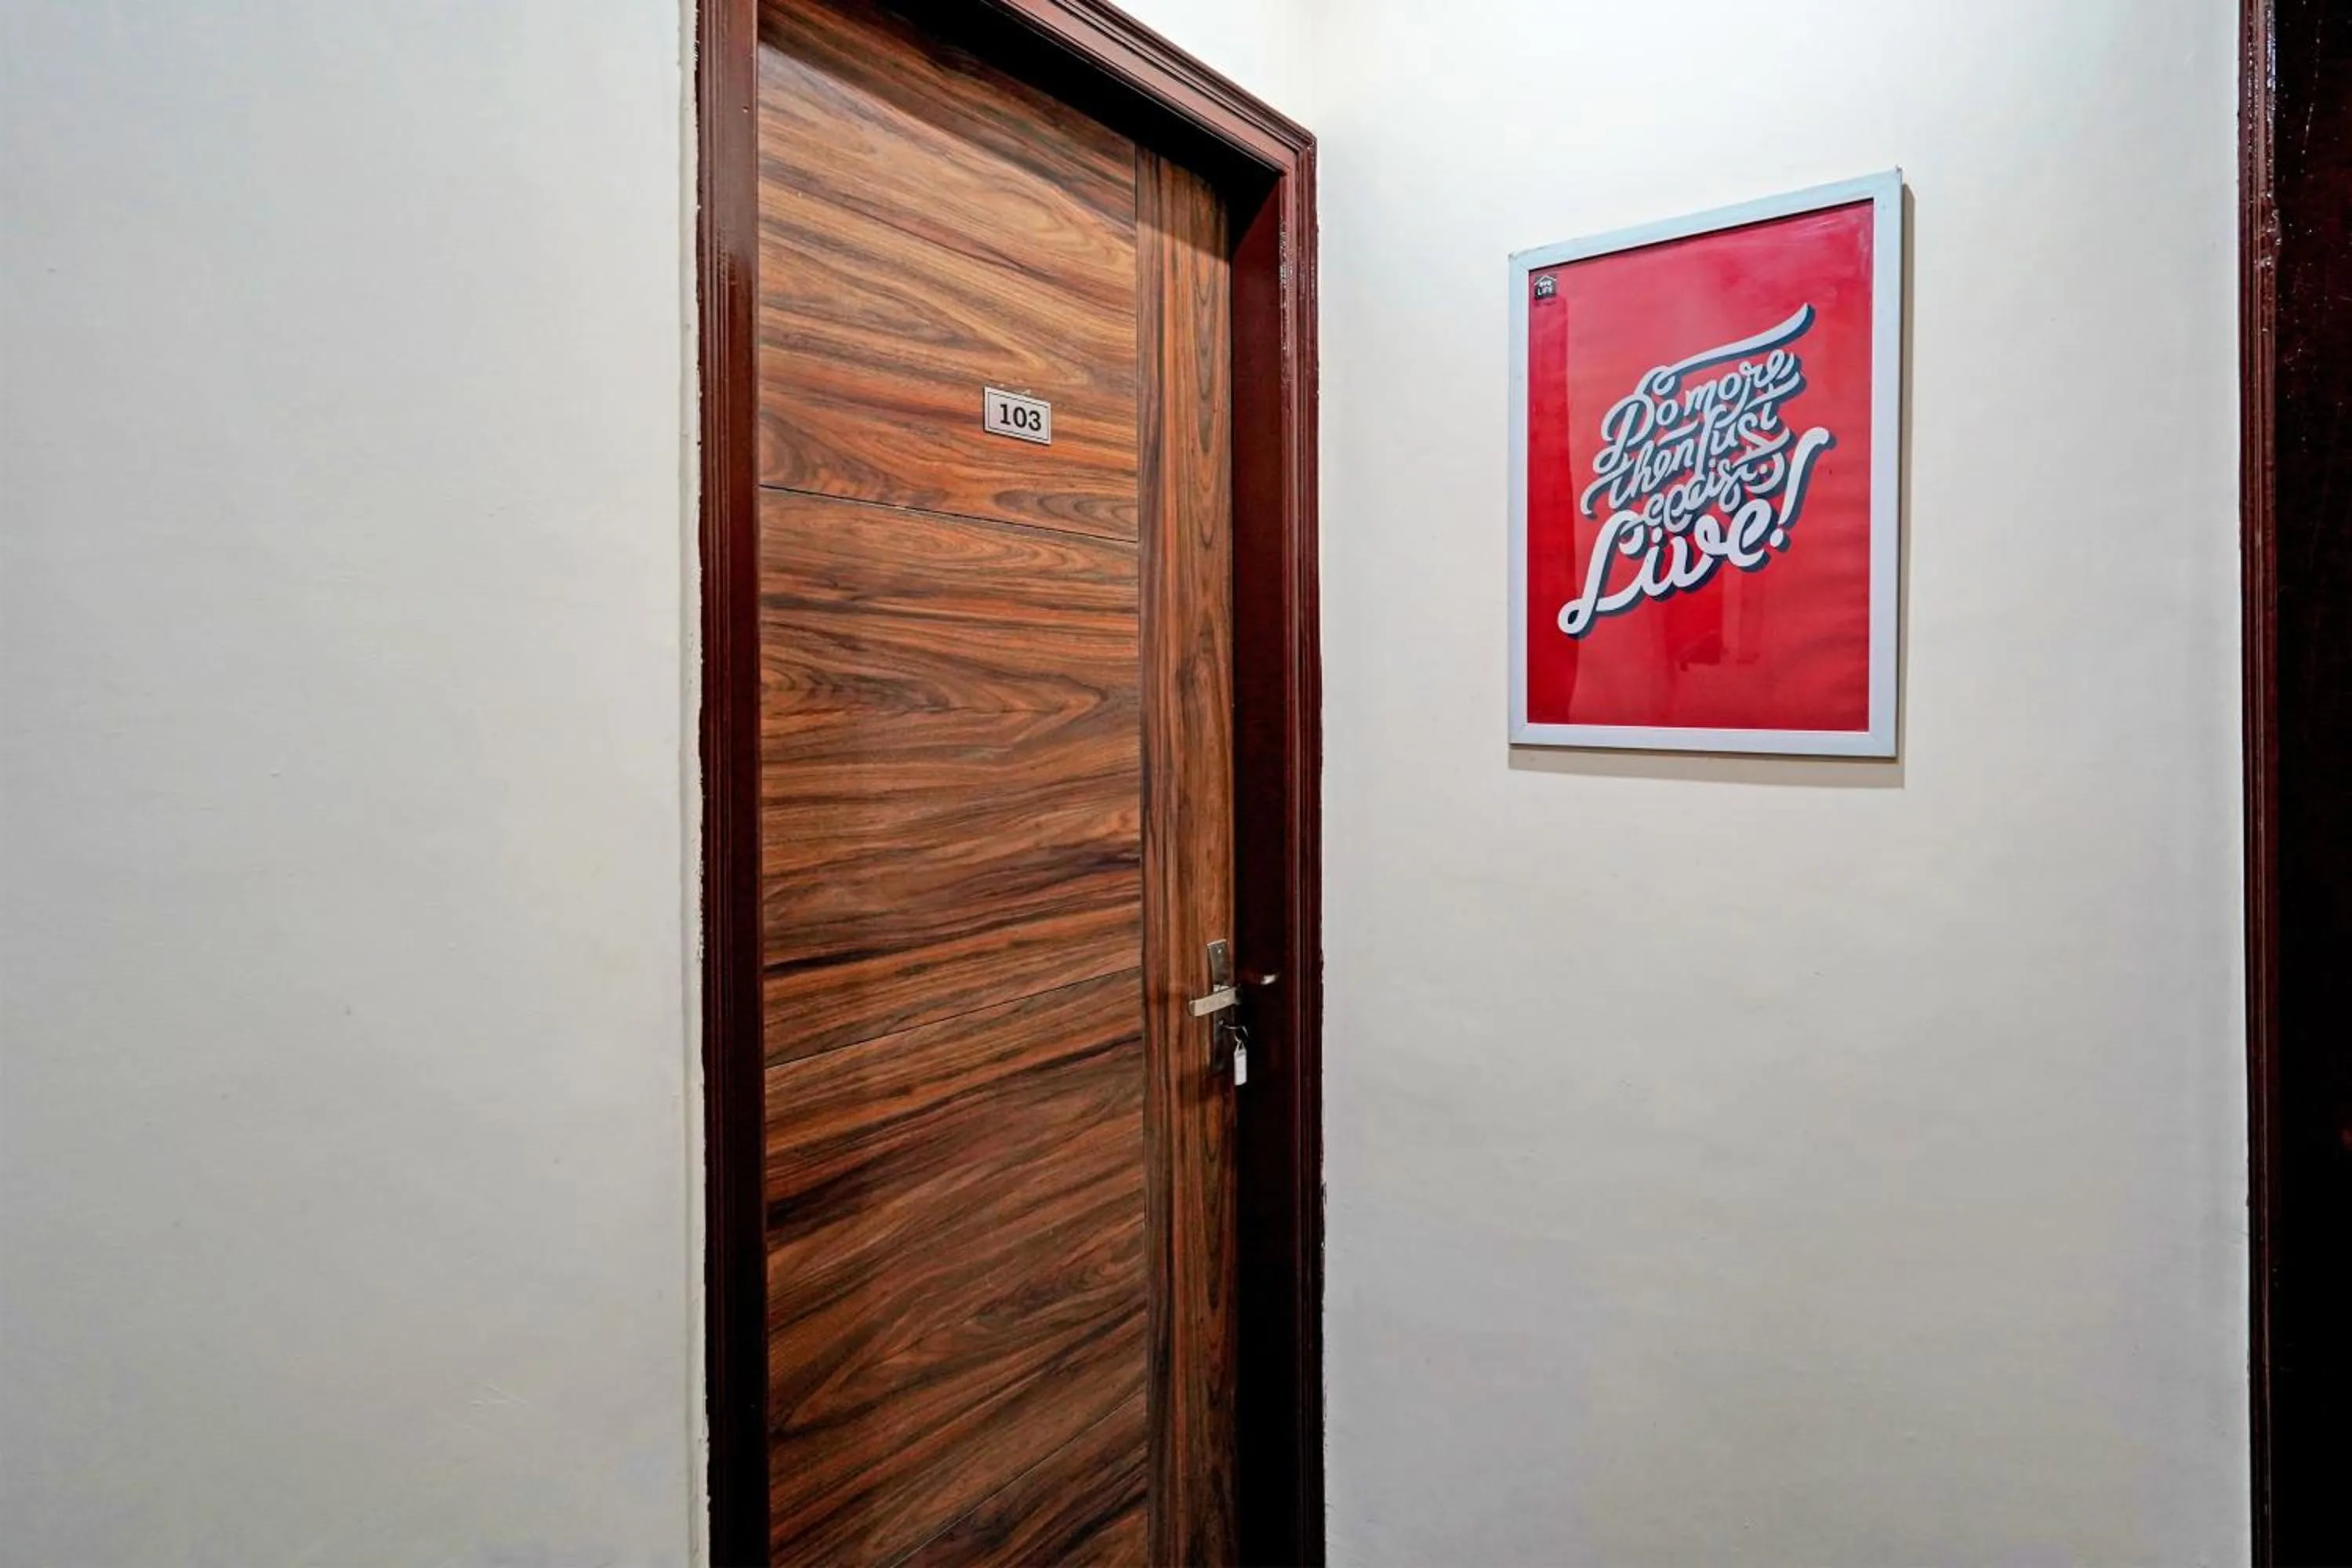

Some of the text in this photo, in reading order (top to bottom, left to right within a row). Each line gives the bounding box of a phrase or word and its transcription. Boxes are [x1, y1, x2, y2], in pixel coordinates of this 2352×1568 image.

[1683, 349, 1795, 416] more
[1000, 403, 1042, 432] 103
[1557, 426, 1830, 634] Live!
